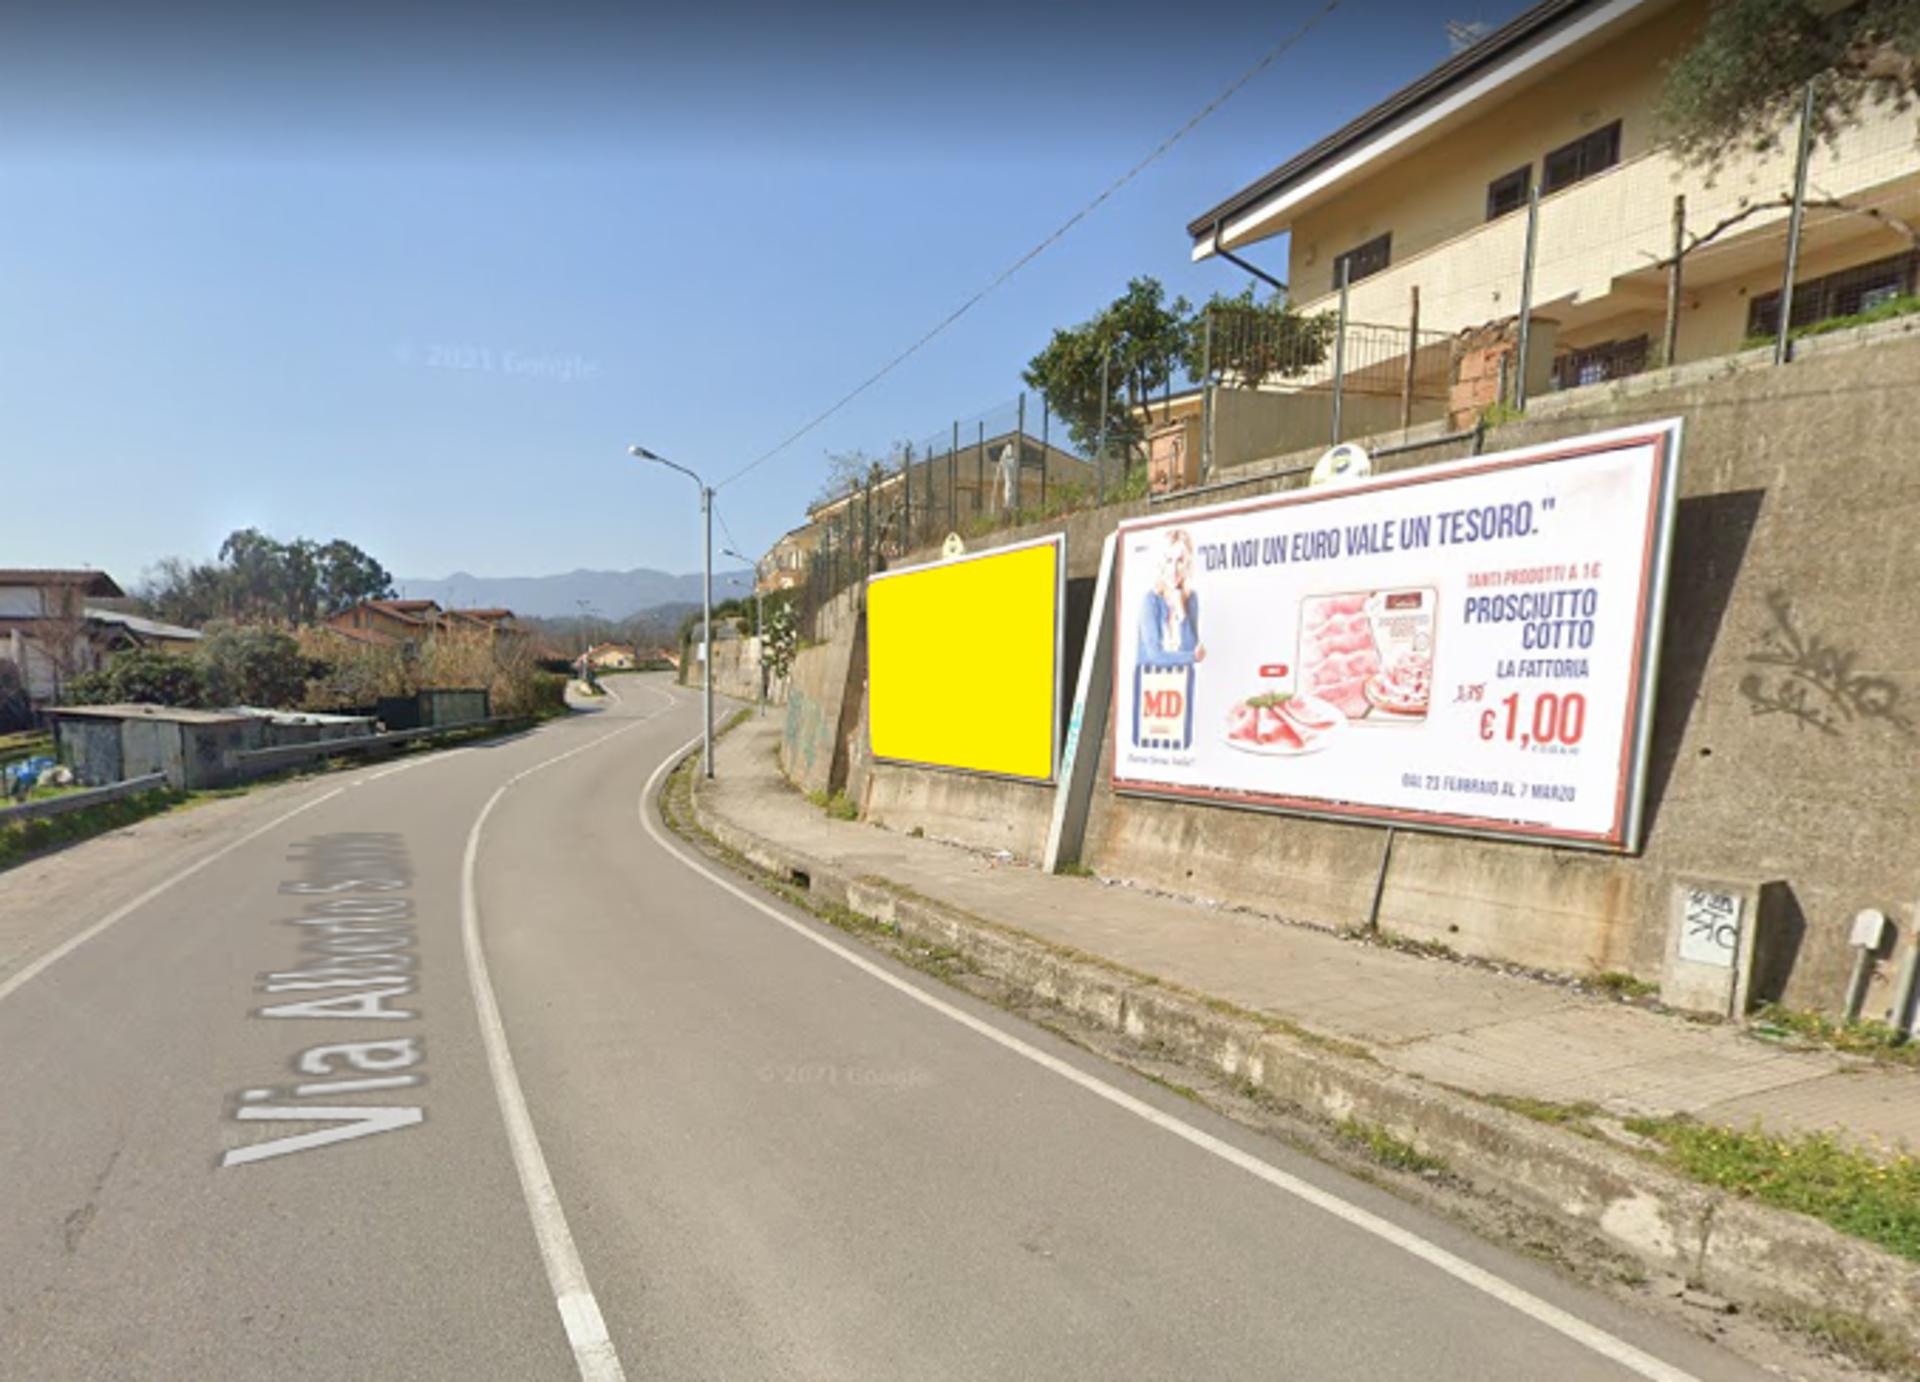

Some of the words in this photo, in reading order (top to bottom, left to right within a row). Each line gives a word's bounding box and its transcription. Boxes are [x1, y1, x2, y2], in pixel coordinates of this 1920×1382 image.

[1231, 538, 1259, 568] NOI
[1262, 535, 1288, 565] UN
[1291, 528, 1340, 562] EURO
[1346, 520, 1395, 557] VALE
[1400, 515, 1431, 550] UN
[1437, 498, 1556, 545] TESORO."
[1504, 565, 1566, 586] PRODOTTI
[1463, 588, 1598, 624] PROSCIUTTO
[1523, 619, 1595, 649] COTTO
[1497, 660, 1515, 678] LA
[1518, 659, 1589, 678] FATTORIA
[1143, 690, 1184, 718] MD
[1502, 692, 1586, 750] 1,00
[1501, 781, 1516, 797] AL
[1531, 784, 1576, 802] MARZO
